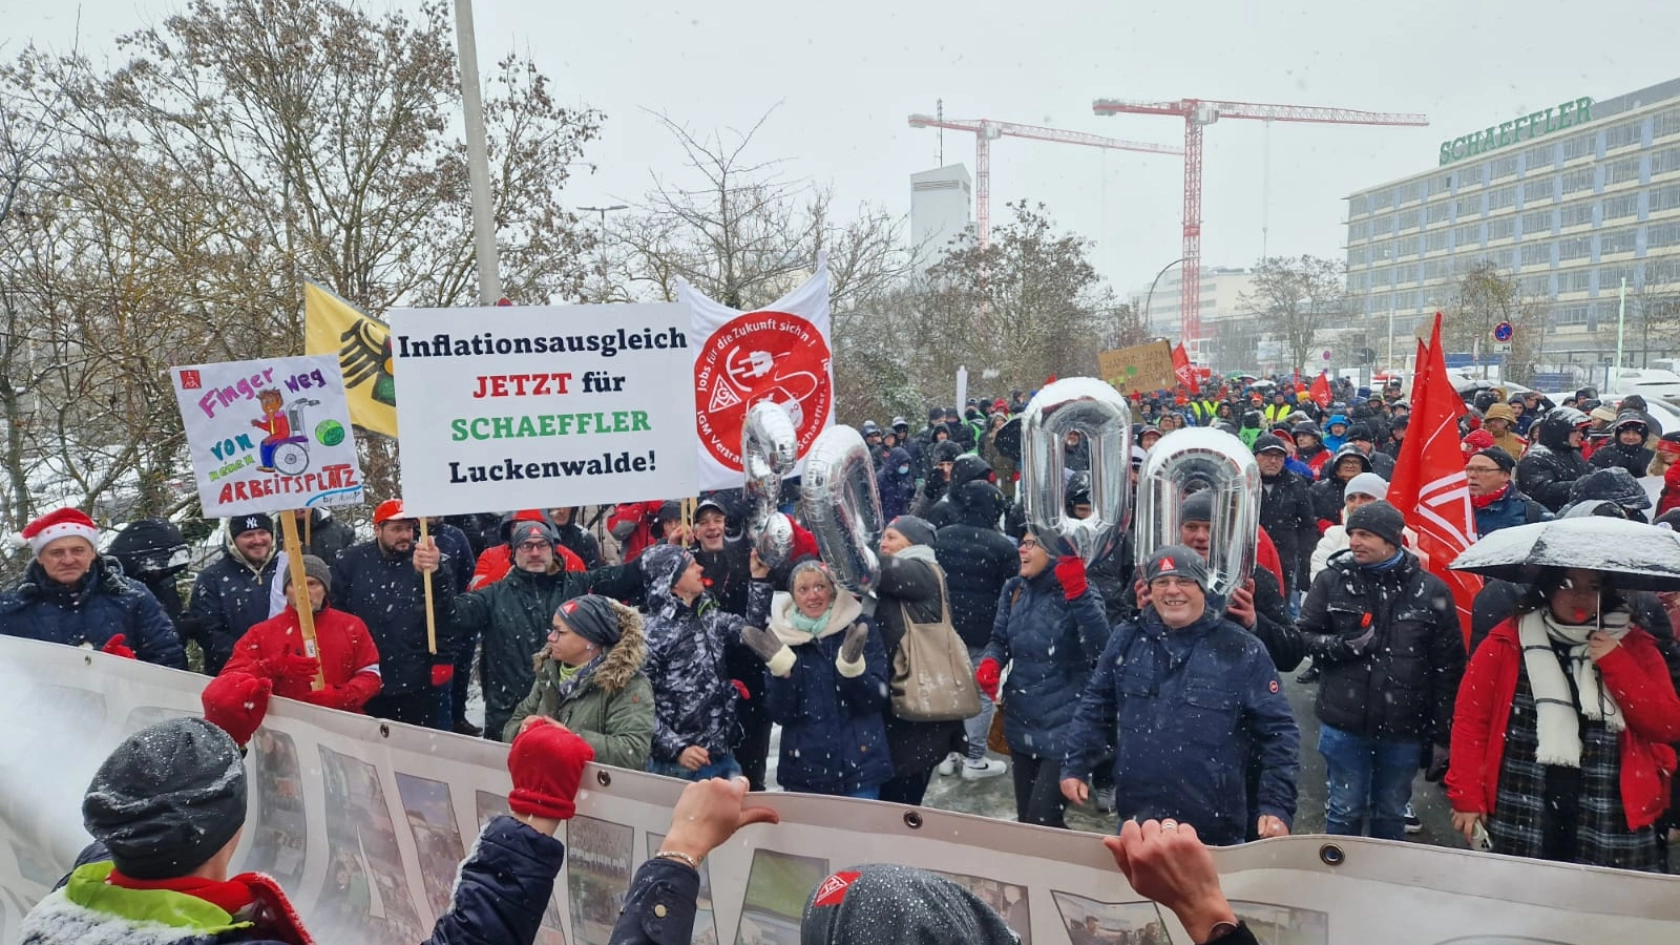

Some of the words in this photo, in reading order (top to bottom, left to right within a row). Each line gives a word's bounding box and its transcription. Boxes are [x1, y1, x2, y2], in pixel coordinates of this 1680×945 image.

[1439, 96, 1594, 167] SCHAEFFLER
[398, 327, 688, 357] Inflationsausgleich
[697, 365, 711, 392] Jobs
[717, 334, 733, 350] die
[732, 318, 777, 338] Zukunft
[198, 367, 274, 418] Finger
[472, 372, 572, 398] JETZT
[582, 371, 626, 393] für
[450, 411, 652, 441] SCHAEFFLER
[697, 410, 713, 435] IGM
[711, 434, 744, 464] Vertra
[449, 450, 656, 484] Luckenwalde!
